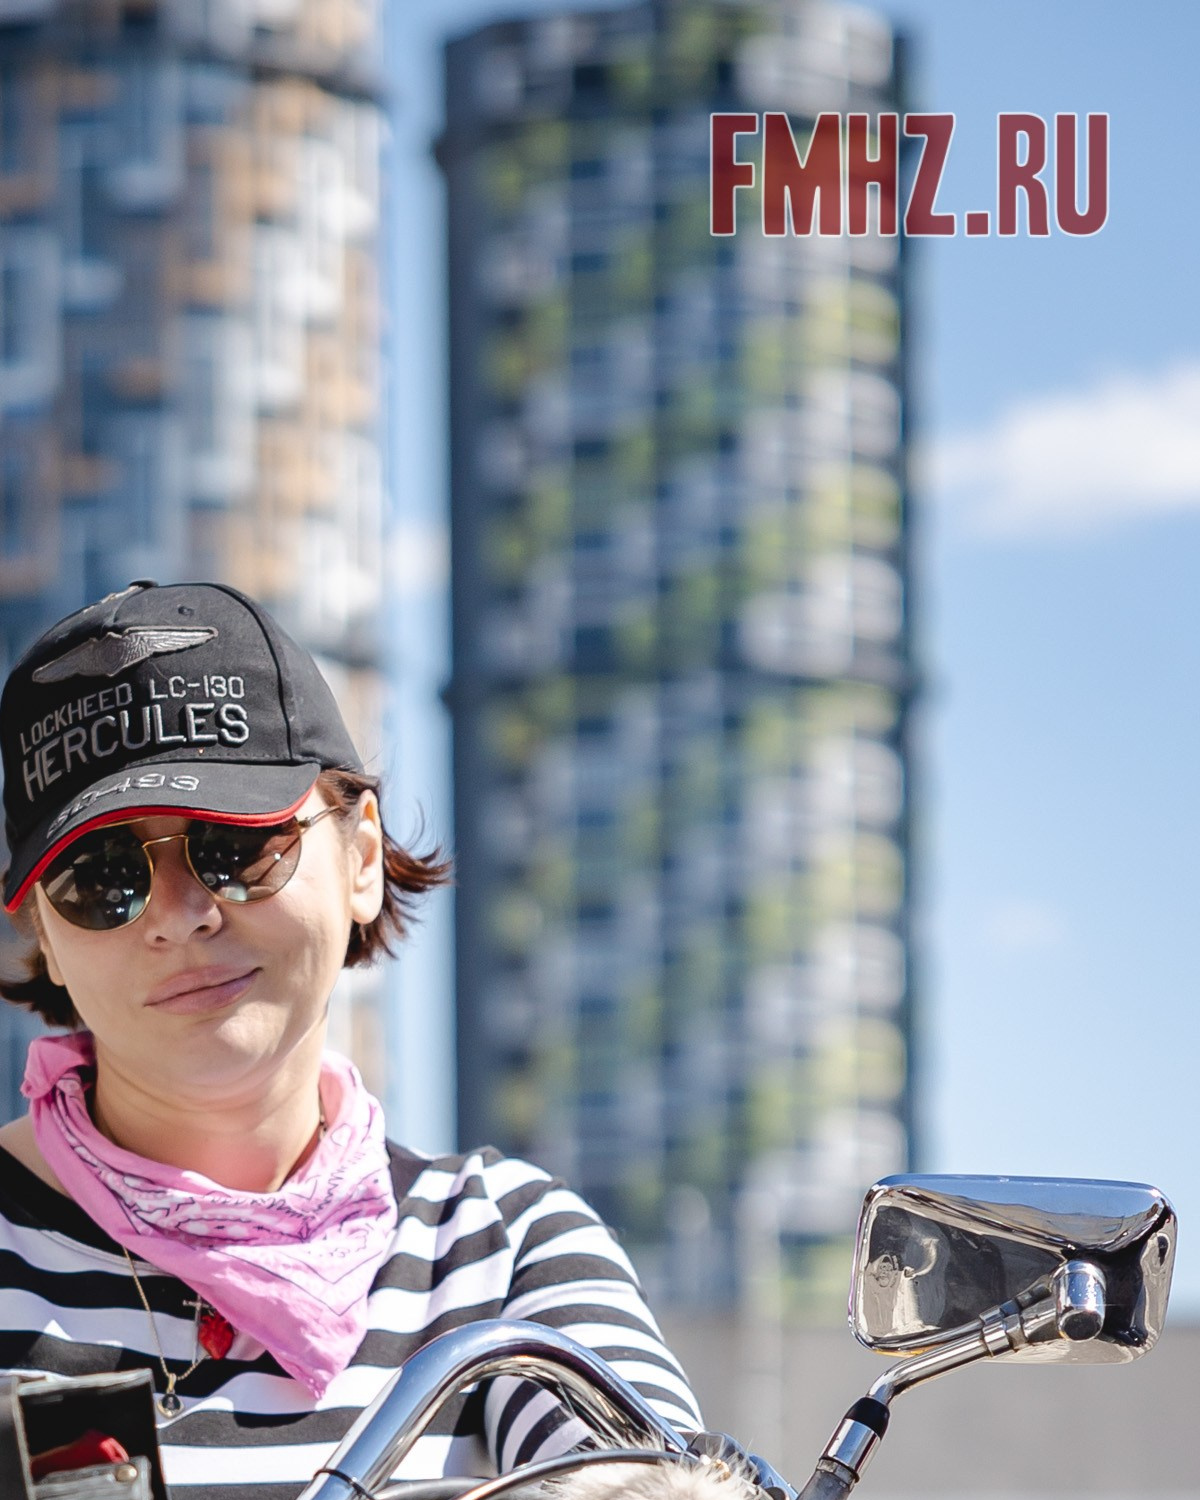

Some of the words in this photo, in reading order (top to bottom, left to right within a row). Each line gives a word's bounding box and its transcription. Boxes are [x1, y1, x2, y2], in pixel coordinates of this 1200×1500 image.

[19, 682, 133, 756] LOCKHEED
[150, 674, 246, 699] LC-130
[22, 702, 249, 803] HERCULES
